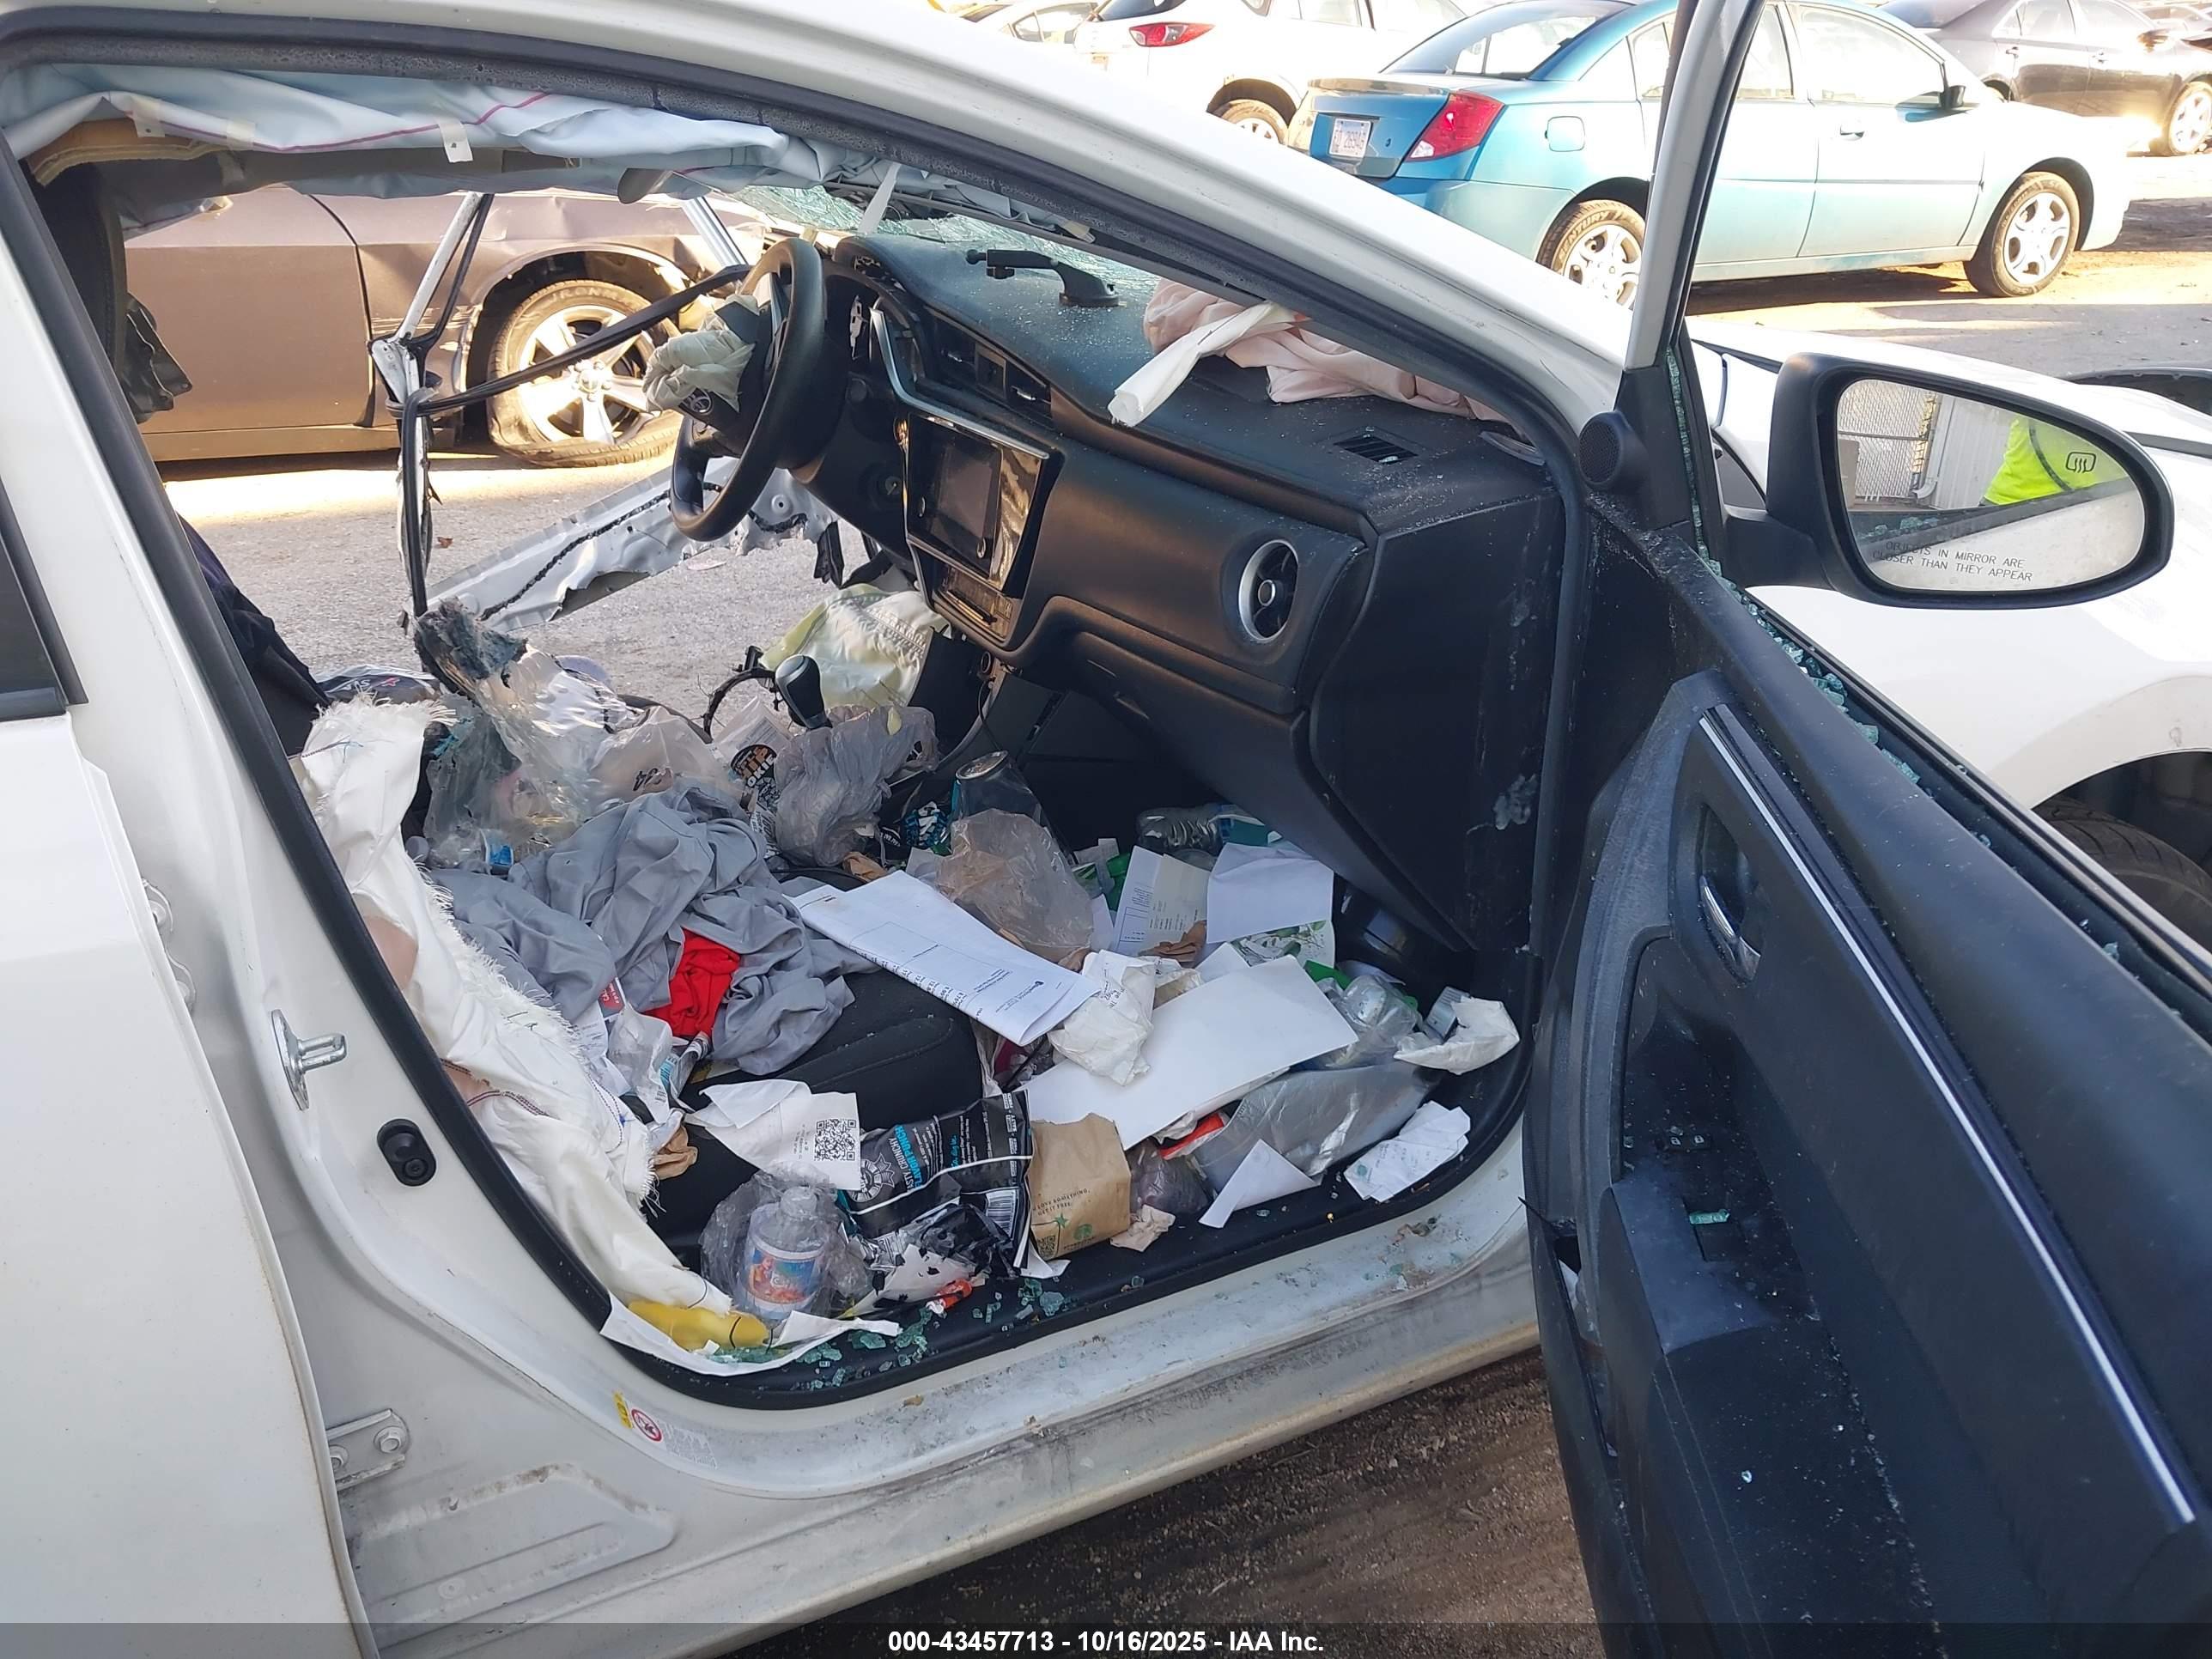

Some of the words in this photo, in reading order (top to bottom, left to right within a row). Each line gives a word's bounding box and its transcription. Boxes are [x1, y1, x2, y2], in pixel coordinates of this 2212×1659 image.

[1872, 550, 1915, 565] CLOSER
[1921, 557, 1948, 570] THAN
[1955, 562, 1984, 574] THEY
[1988, 568, 2033, 581] APPEAR
[1886, 541, 1932, 556] OBJECTS
[1938, 548, 1949, 558] IN
[1955, 551, 1996, 565] MIRROR
[2002, 557, 2026, 568] ARE
[888, 1136, 908, 1170] CRUNCHY
[895, 1125, 914, 1155] PUNCH
[902, 1167, 914, 1192] ASTY,
[907, 1157, 922, 1189] FLAVOR
